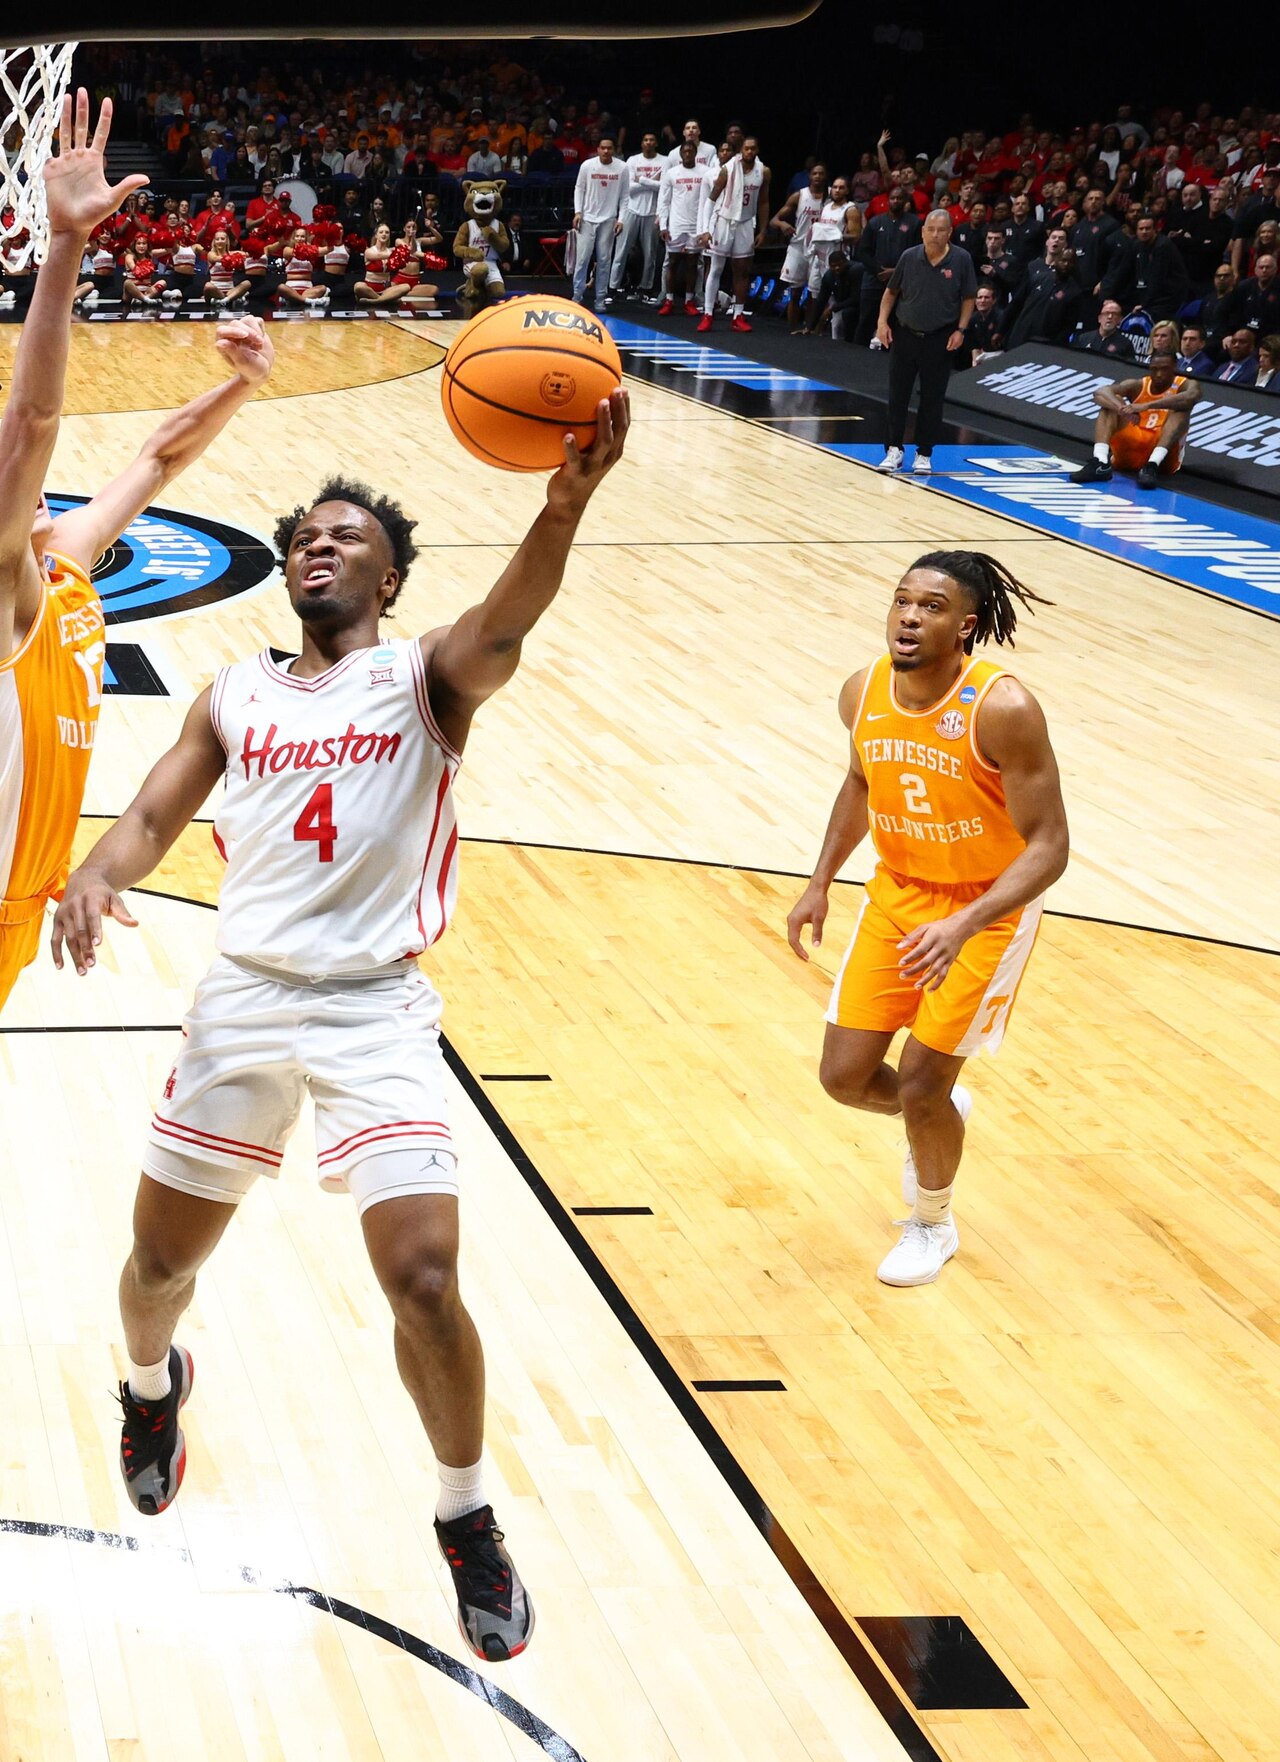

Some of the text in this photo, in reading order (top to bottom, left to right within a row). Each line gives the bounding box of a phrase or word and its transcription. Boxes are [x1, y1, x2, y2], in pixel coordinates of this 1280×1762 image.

[88, 312, 250, 320] ELITE
[524, 310, 604, 345] NCAA
[1145, 413, 1159, 429] 8
[949, 477, 1280, 594] INDIANAPO
[140, 559, 211, 576] 16
[941, 710, 964, 733] SEC
[240, 722, 402, 782] Houston
[863, 738, 963, 781] TENNESSEE
[899, 773, 933, 815] 2
[294, 783, 338, 862] 4
[869, 809, 984, 844] VOLUNTEERS
[981, 995, 1010, 1034] T
